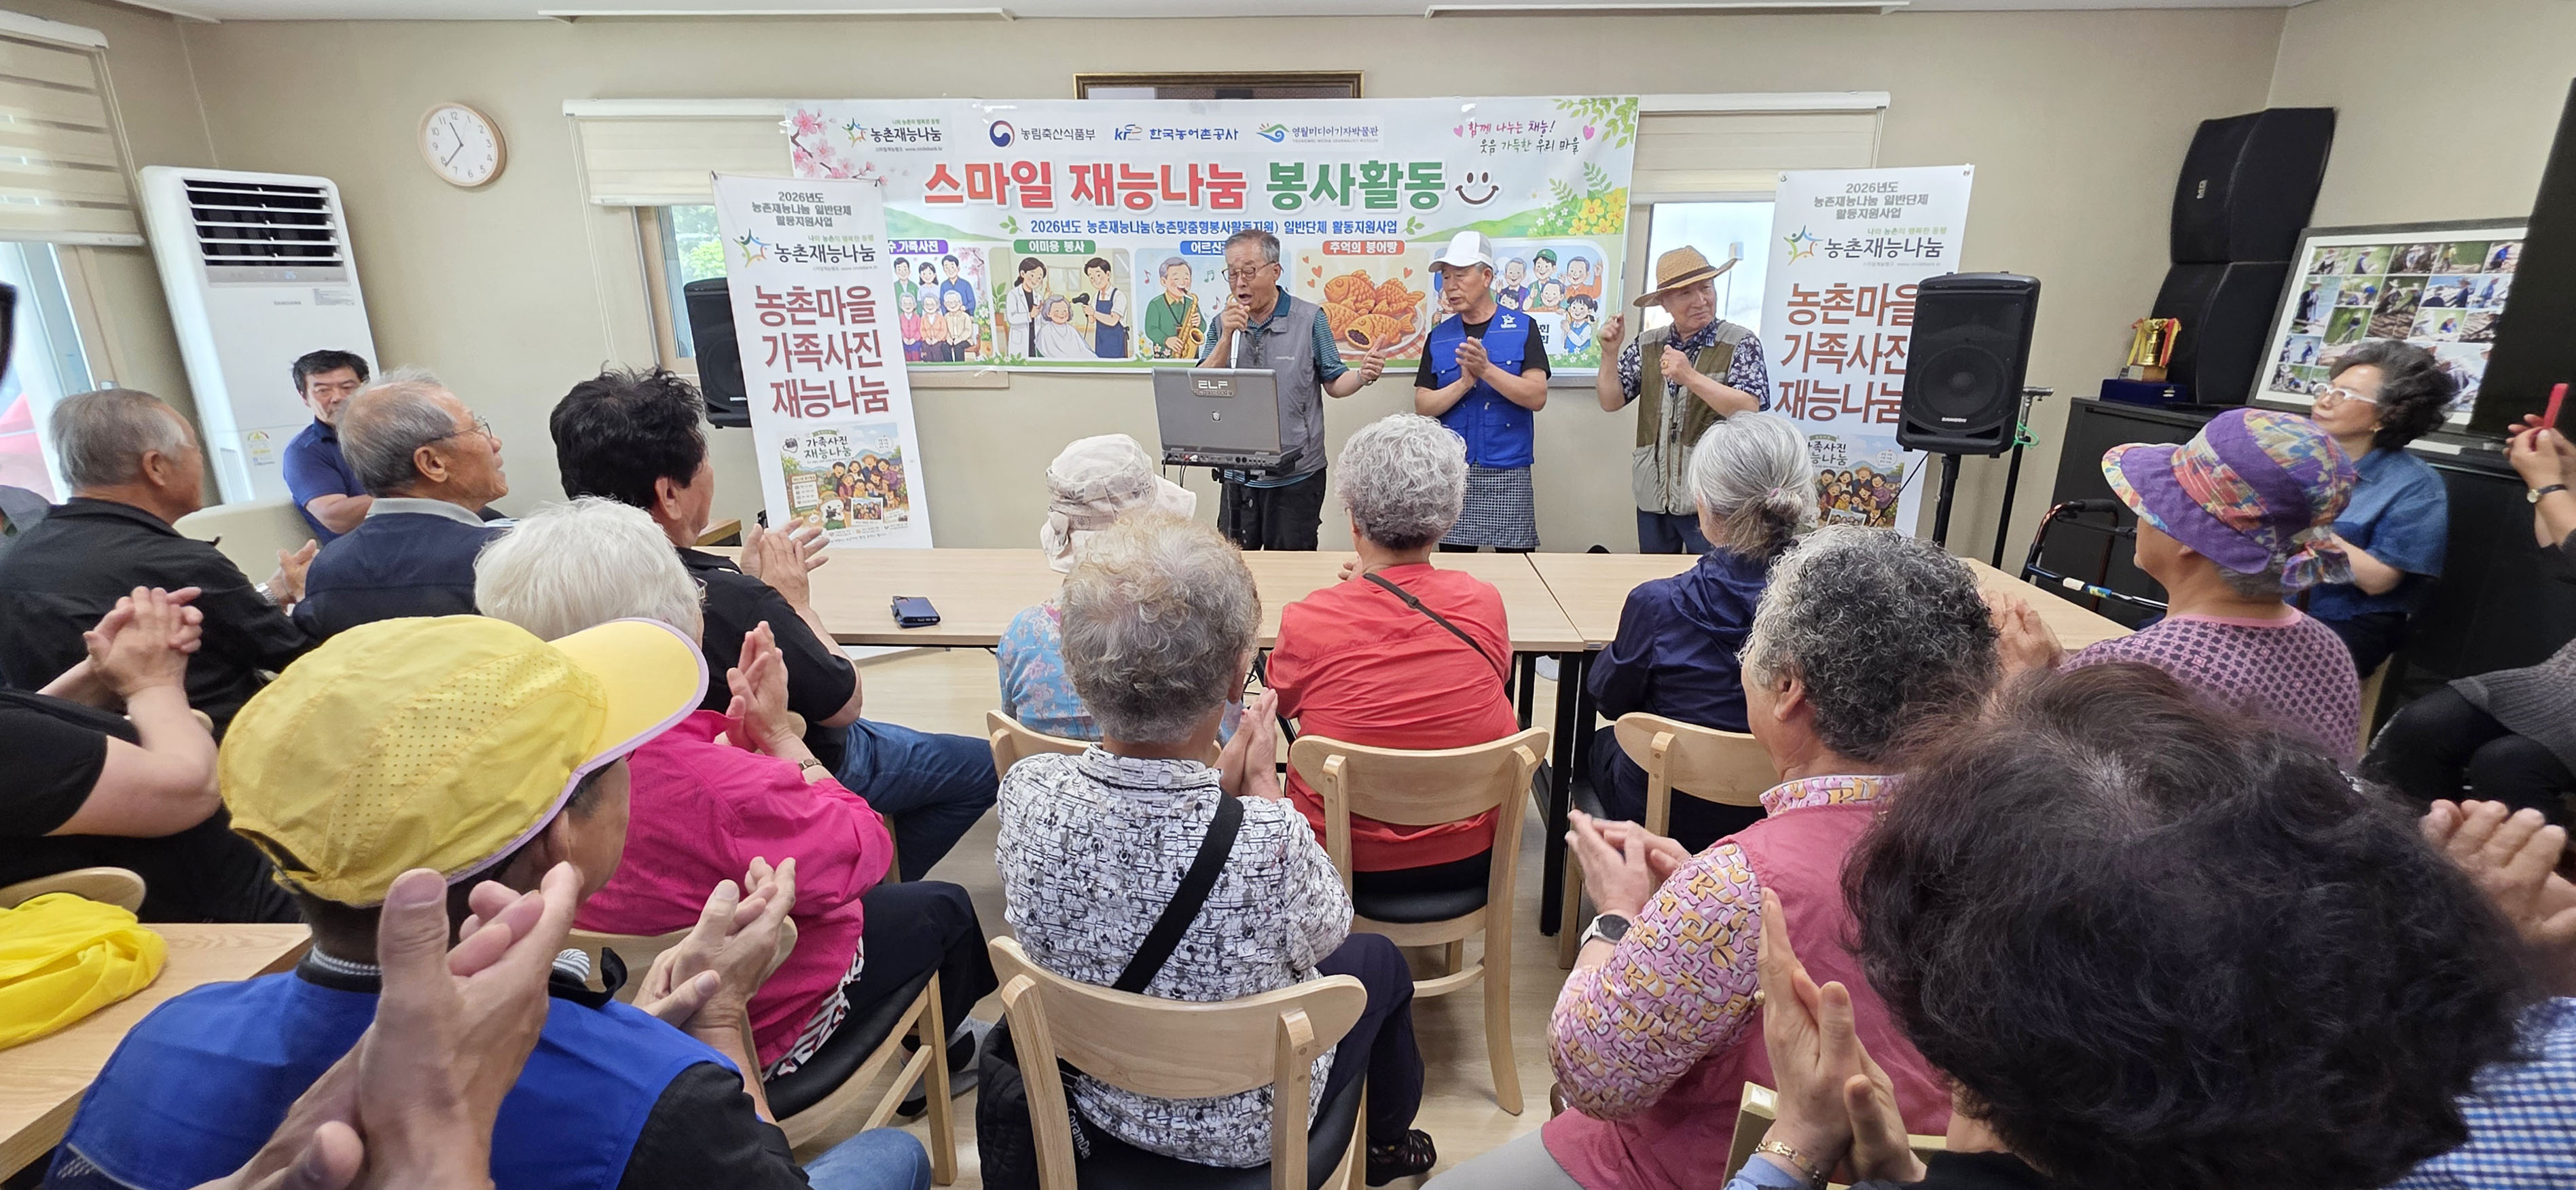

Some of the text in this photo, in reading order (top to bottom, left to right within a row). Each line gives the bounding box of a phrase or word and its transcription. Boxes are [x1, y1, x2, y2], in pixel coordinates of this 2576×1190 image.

[439, 117, 446, 125] 11
[450, 111, 458, 120] 12
[431, 127, 439, 136] 10
[478, 125, 484, 133] 2
[871, 127, 942, 143] 농촌재능나눔
[1021, 128, 1096, 141] 농림축산식품부
[1149, 128, 1239, 141] 한국농어촌공사
[1292, 126, 1379, 137] 영월미디어기자박물관
[1468, 121, 1491, 138] 함께
[1496, 121, 1523, 134] 나누는
[433, 142, 438, 150] 9
[486, 139, 492, 147] 3
[1480, 137, 1580, 156] 웃음 가득한 우리 마을
[468, 169, 473, 178] 6
[480, 164, 486, 173] 5
[924, 160, 1446, 210] 스마일 재능나눔 봉사활동
[1846, 181, 1898, 194] 2026년도
[778, 192, 824, 203] 2026년도
[1884, 194, 1929, 205] 일반단체
[815, 204, 852, 216] 일반단체
[1031, 219, 1081, 233] 2026년도
[1284, 220, 1327, 234] 일반단체
[1332, 220, 1398, 234] 활동지원사업
[888, 240, 939, 253] 수.가족사진
[1029, 240, 1085, 253] 이미용 봉사
[1330, 241, 1360, 253] 추억의
[1824, 237, 1944, 259] 농촌재능나눔
[774, 243, 875, 264] 농촌재능나눔
[755, 285, 876, 327] 농촌마을
[1787, 283, 1919, 327] 농촌마을
[762, 329, 883, 373] 가족사진
[1780, 331, 1908, 375] 가족사진
[1198, 380, 1228, 389] ELF
[770, 376, 889, 418] 재능나눔
[1774, 379, 1902, 424] 재능나눔
[805, 435, 848, 448] 가족사진
[804, 446, 852, 459] 재능나눔
[1811, 452, 1848, 466] 능나눔
